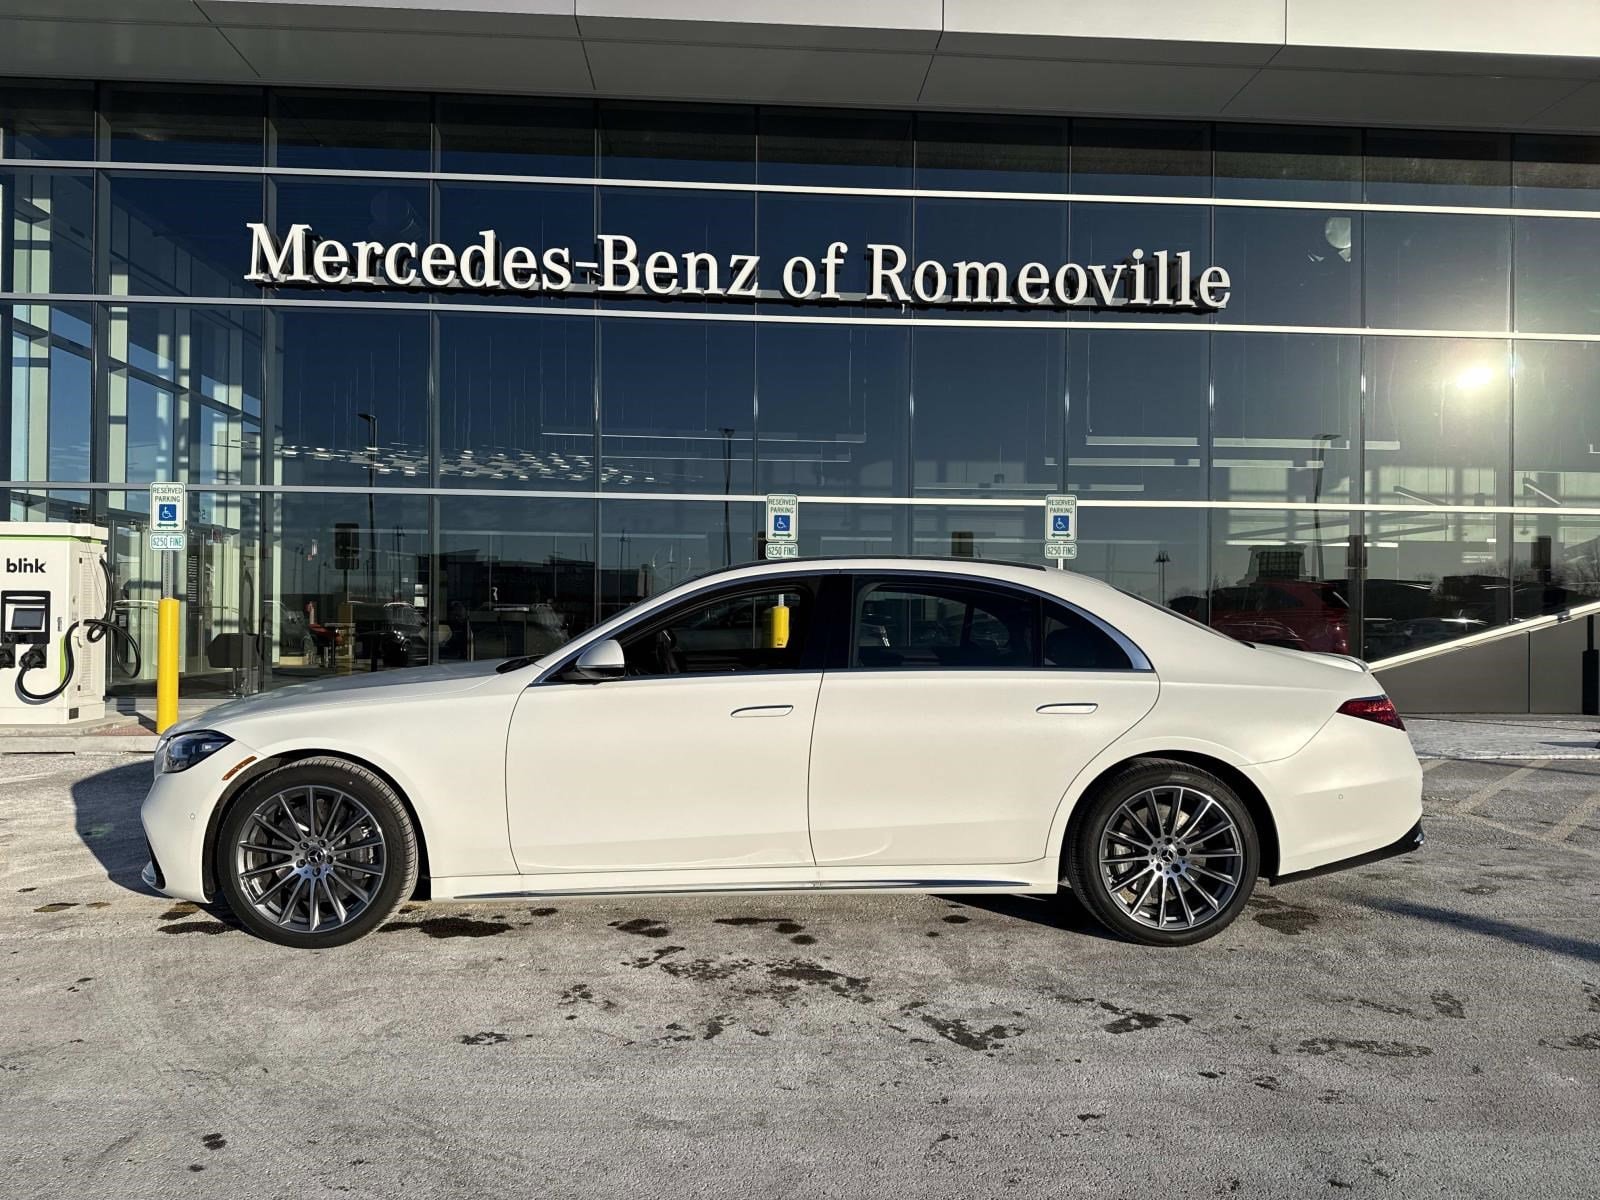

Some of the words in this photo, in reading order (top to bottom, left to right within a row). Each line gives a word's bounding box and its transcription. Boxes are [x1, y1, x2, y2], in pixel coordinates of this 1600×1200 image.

[242, 222, 760, 297] Mercedes-Benz
[783, 241, 848, 300] of
[866, 243, 1231, 309] Romeoville
[154, 495, 181, 503] PARKING
[152, 537, 168, 547] $250
[169, 537, 183, 547] FINE
[768, 546, 782, 555] $250
[783, 546, 796, 556] FINE
[1047, 546, 1061, 555] $250
[1062, 546, 1075, 556] FINE
[6, 558, 47, 573] blink
